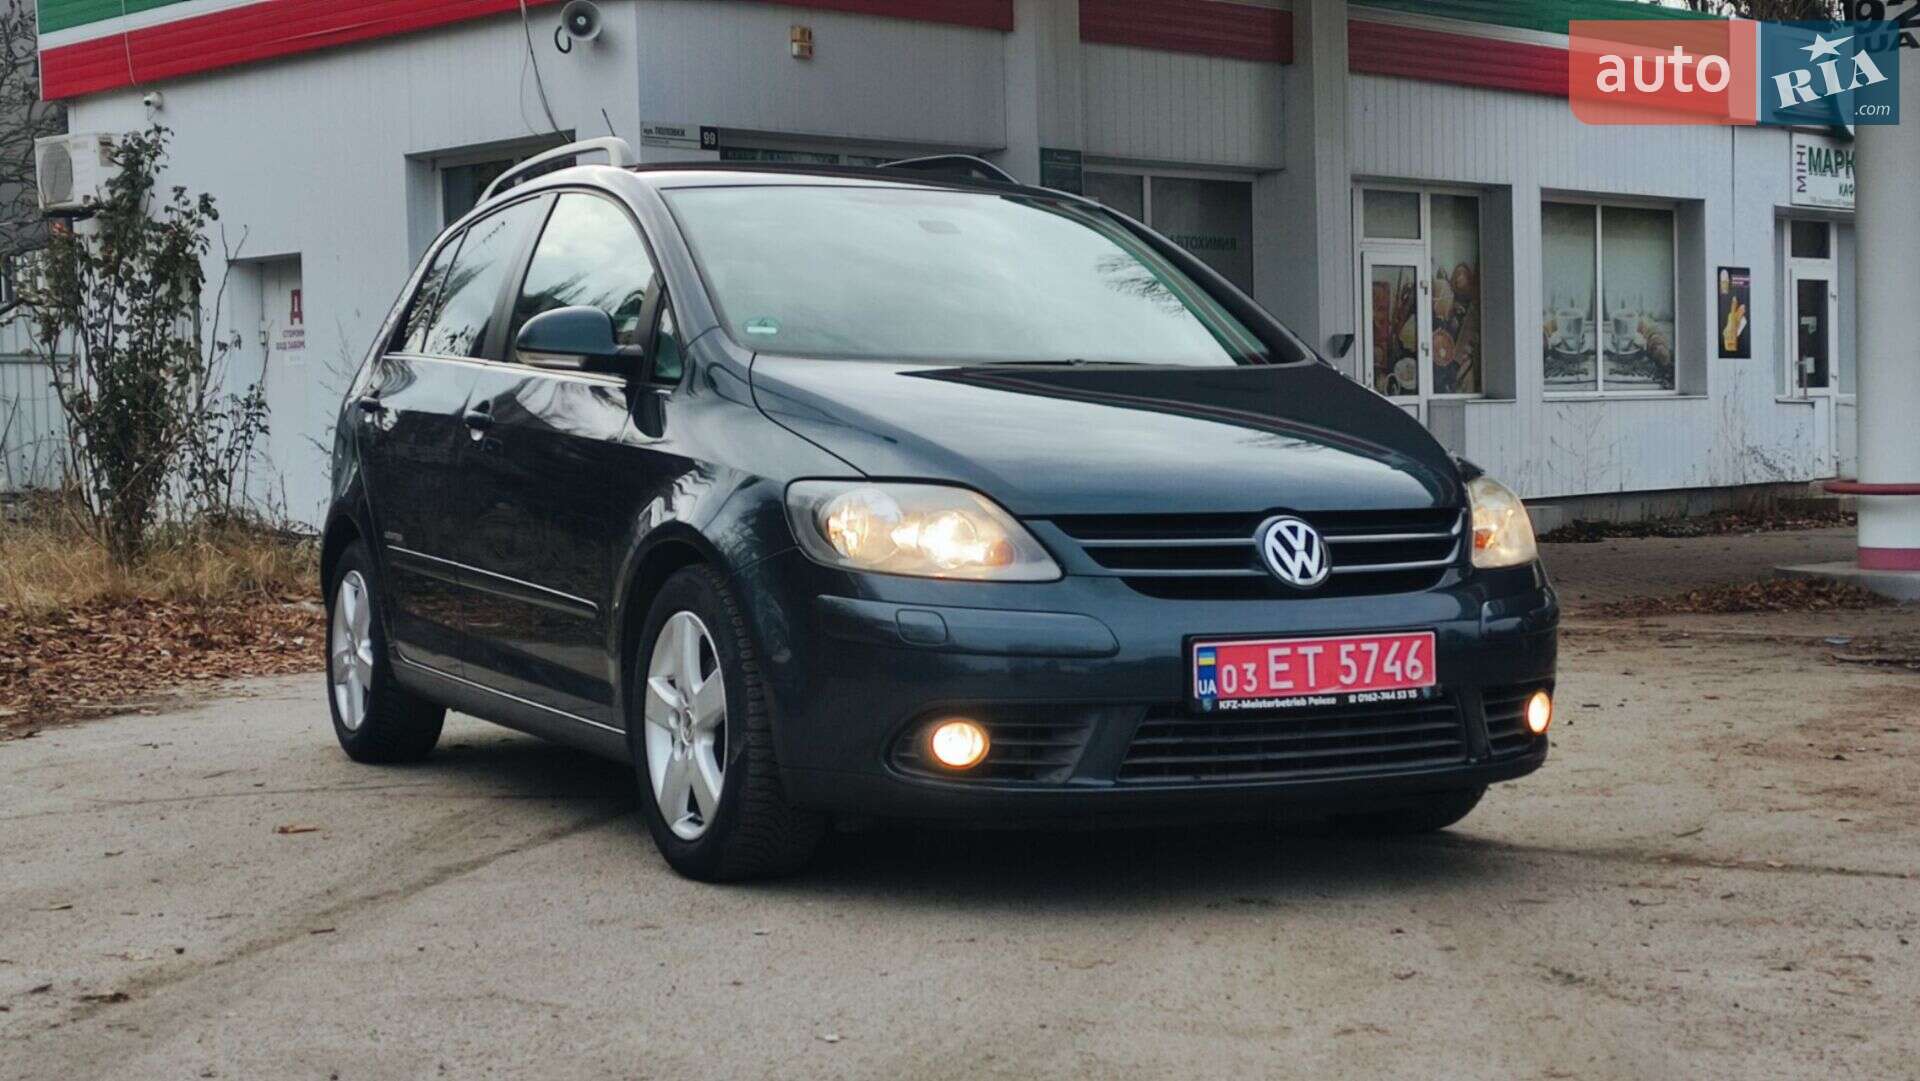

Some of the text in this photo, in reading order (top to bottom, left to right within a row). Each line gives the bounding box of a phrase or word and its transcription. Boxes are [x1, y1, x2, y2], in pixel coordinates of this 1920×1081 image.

[703, 131, 717, 146] 99
[1221, 640, 1424, 693] 03 ET 5746
[1199, 680, 1217, 695] UA
